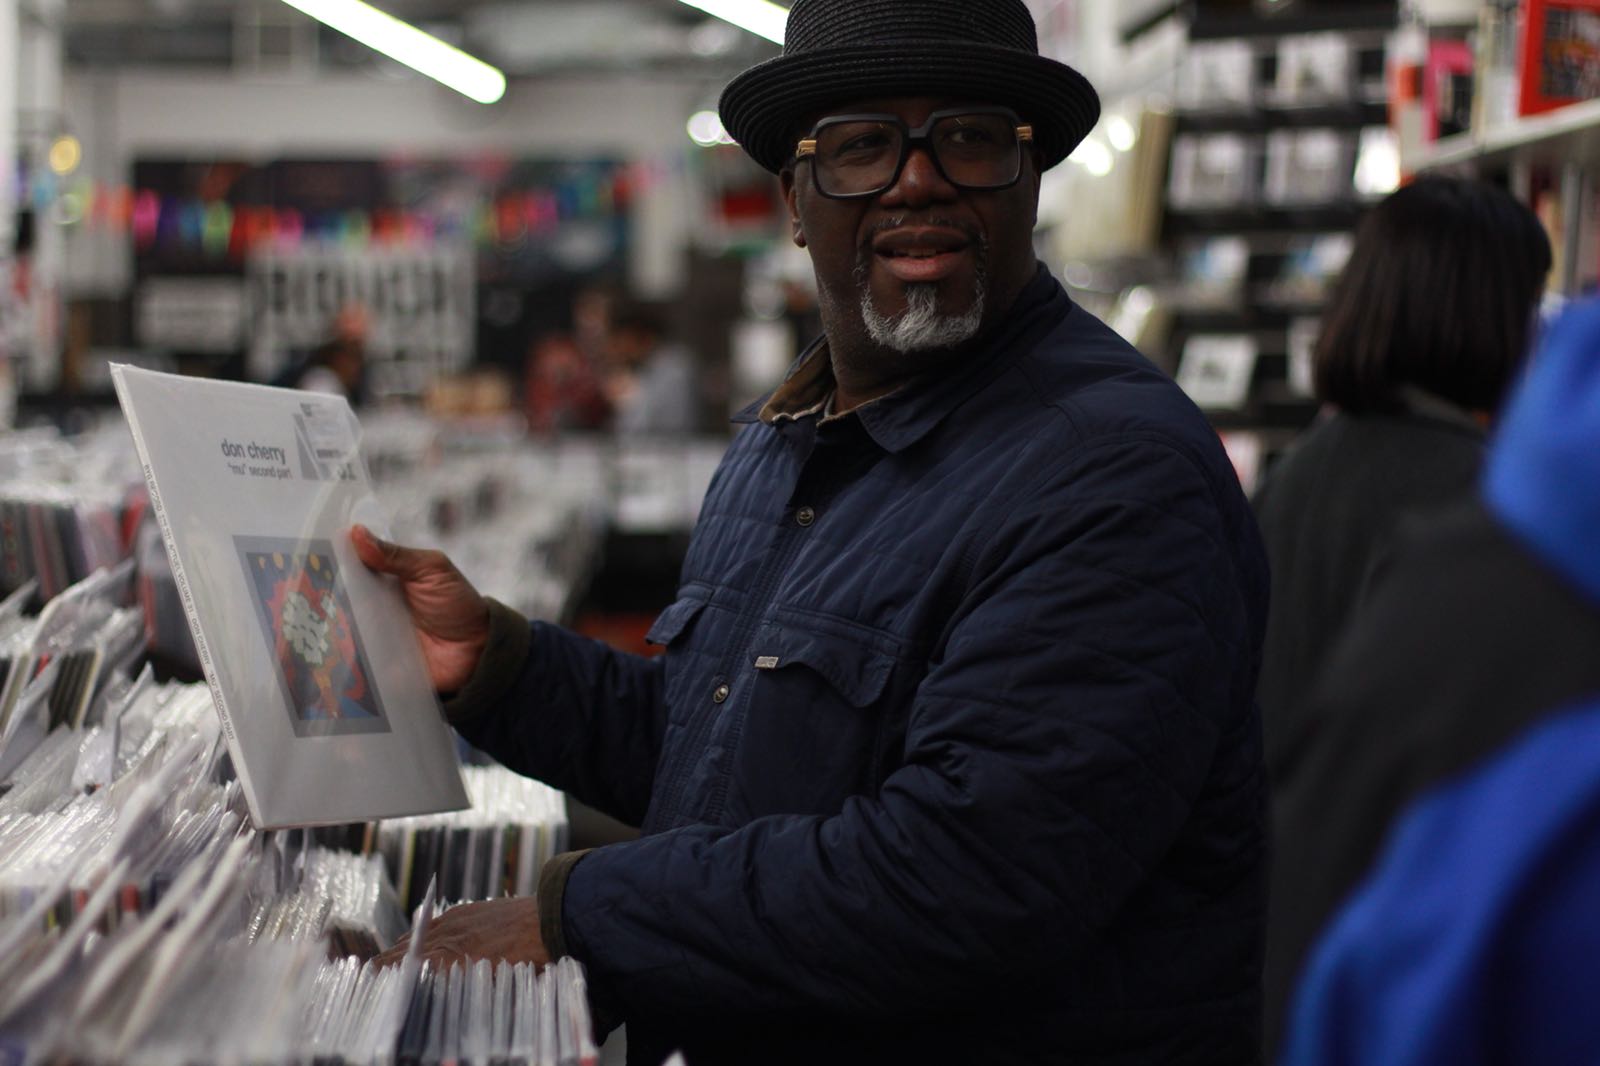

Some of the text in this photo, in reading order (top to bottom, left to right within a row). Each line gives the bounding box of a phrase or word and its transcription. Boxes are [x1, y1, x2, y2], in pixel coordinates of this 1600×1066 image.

[221, 438, 286, 465] don cherry
[248, 465, 277, 477] second
[277, 466, 293, 480] part
[178, 573, 190, 602] VOLUME
[192, 618, 200, 634] DON
[197, 635, 209, 665] CHERRY
[215, 690, 228, 720] SECOND
[224, 722, 233, 740] PART
